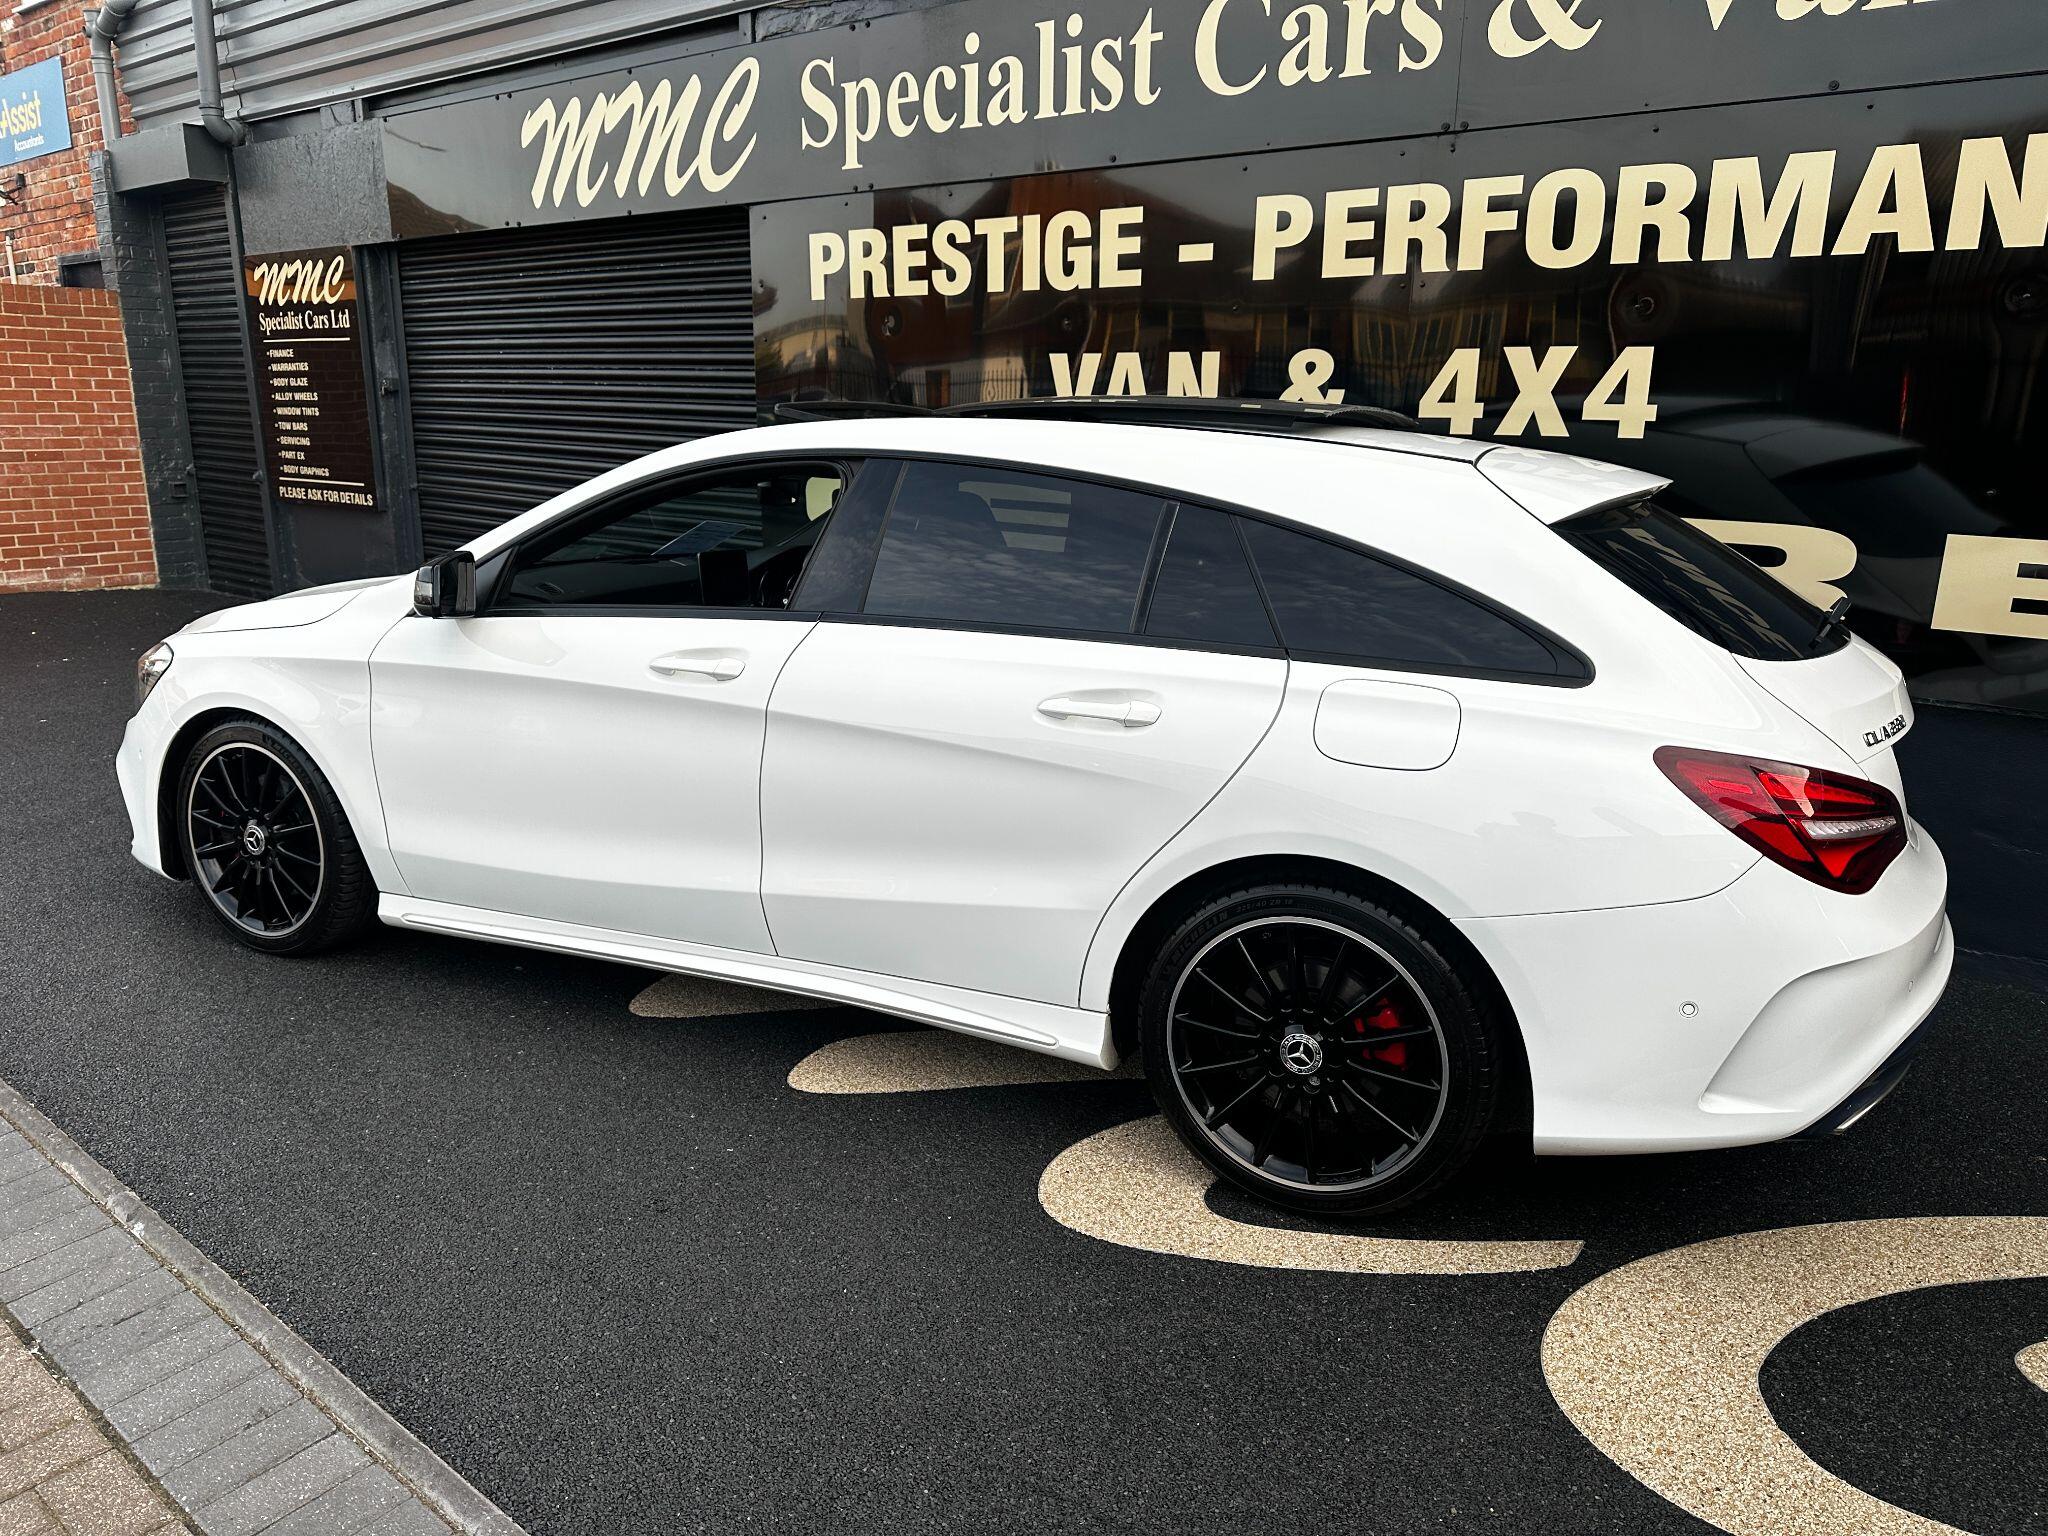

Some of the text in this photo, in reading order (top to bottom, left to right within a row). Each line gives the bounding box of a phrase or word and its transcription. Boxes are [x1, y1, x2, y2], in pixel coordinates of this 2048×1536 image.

[801, 8, 1163, 170] Specialist
[1195, 0, 1443, 96] Cars
[0, 90, 42, 139] Assist
[14, 133, 44, 152] Accountants
[809, 206, 1143, 300] PRESTIGE
[1253, 133, 2048, 280] PERFORMAN
[259, 309, 350, 335] Specialist Cars Ltd
[269, 349, 294, 357] FINANCE
[271, 362, 309, 371] WARRANTIES
[273, 377, 308, 386] BODY GLAZE
[275, 392, 318, 401] ALLOY WHEELS
[1049, 346, 1657, 439] VAN & 4X4
[276, 406, 319, 416] WINDOW TINTS
[278, 421, 308, 431] TOW BARS
[280, 435, 310, 446] SERVICING
[281, 450, 305, 460] PART EX
[283, 464, 329, 476] BODY GRAPHICS
[279, 486, 373, 506] PLEASE ASK FOR DETAILS
